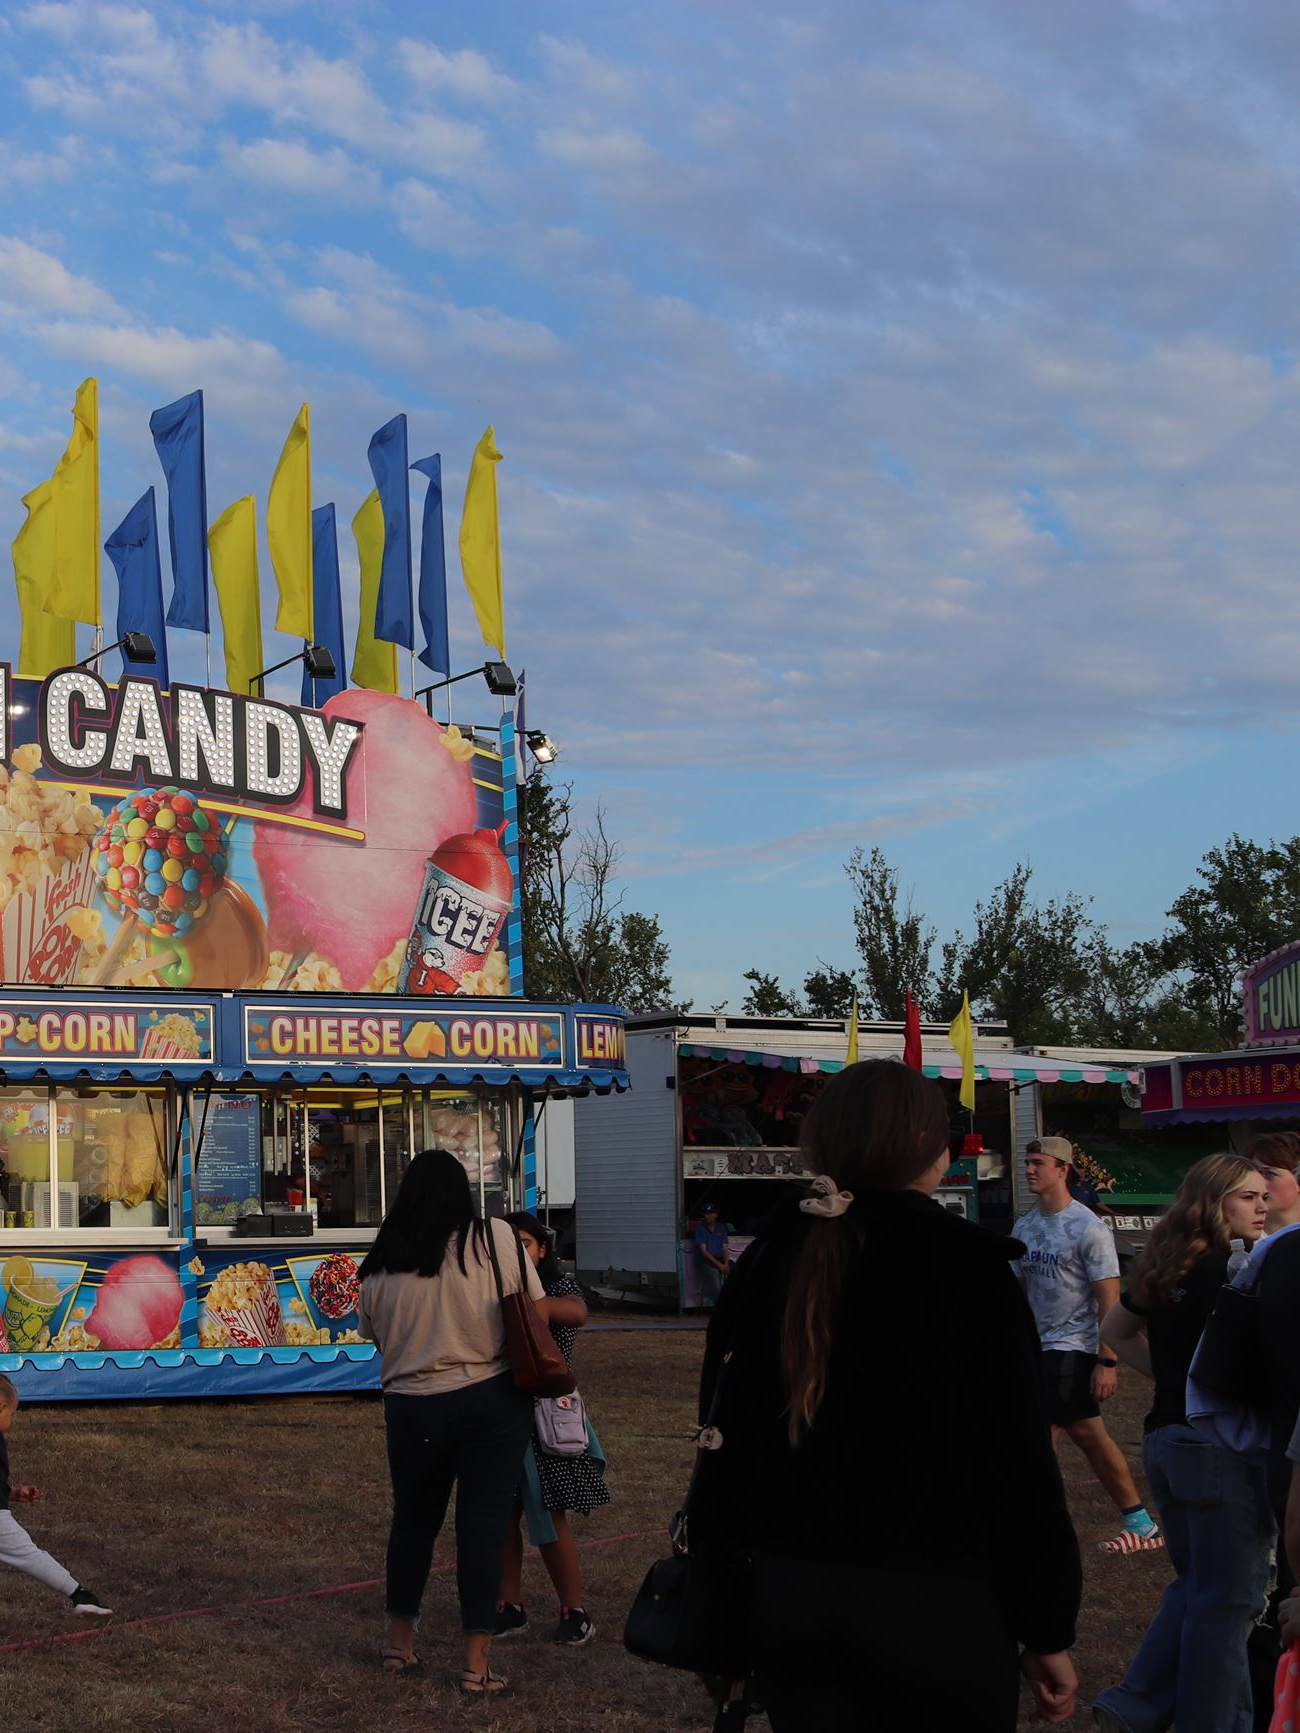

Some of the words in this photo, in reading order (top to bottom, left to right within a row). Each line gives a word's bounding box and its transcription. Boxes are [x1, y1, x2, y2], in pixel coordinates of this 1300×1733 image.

[46, 671, 359, 810] CANDY
[46, 867, 82, 922] fresh
[418, 876, 501, 955] ICEE
[1258, 959, 1300, 1032] FUN
[37, 1011, 138, 1053] CORN
[270, 1015, 402, 1057] CHEESE
[450, 1019, 540, 1058] CORN
[1186, 1065, 1264, 1098] CORN
